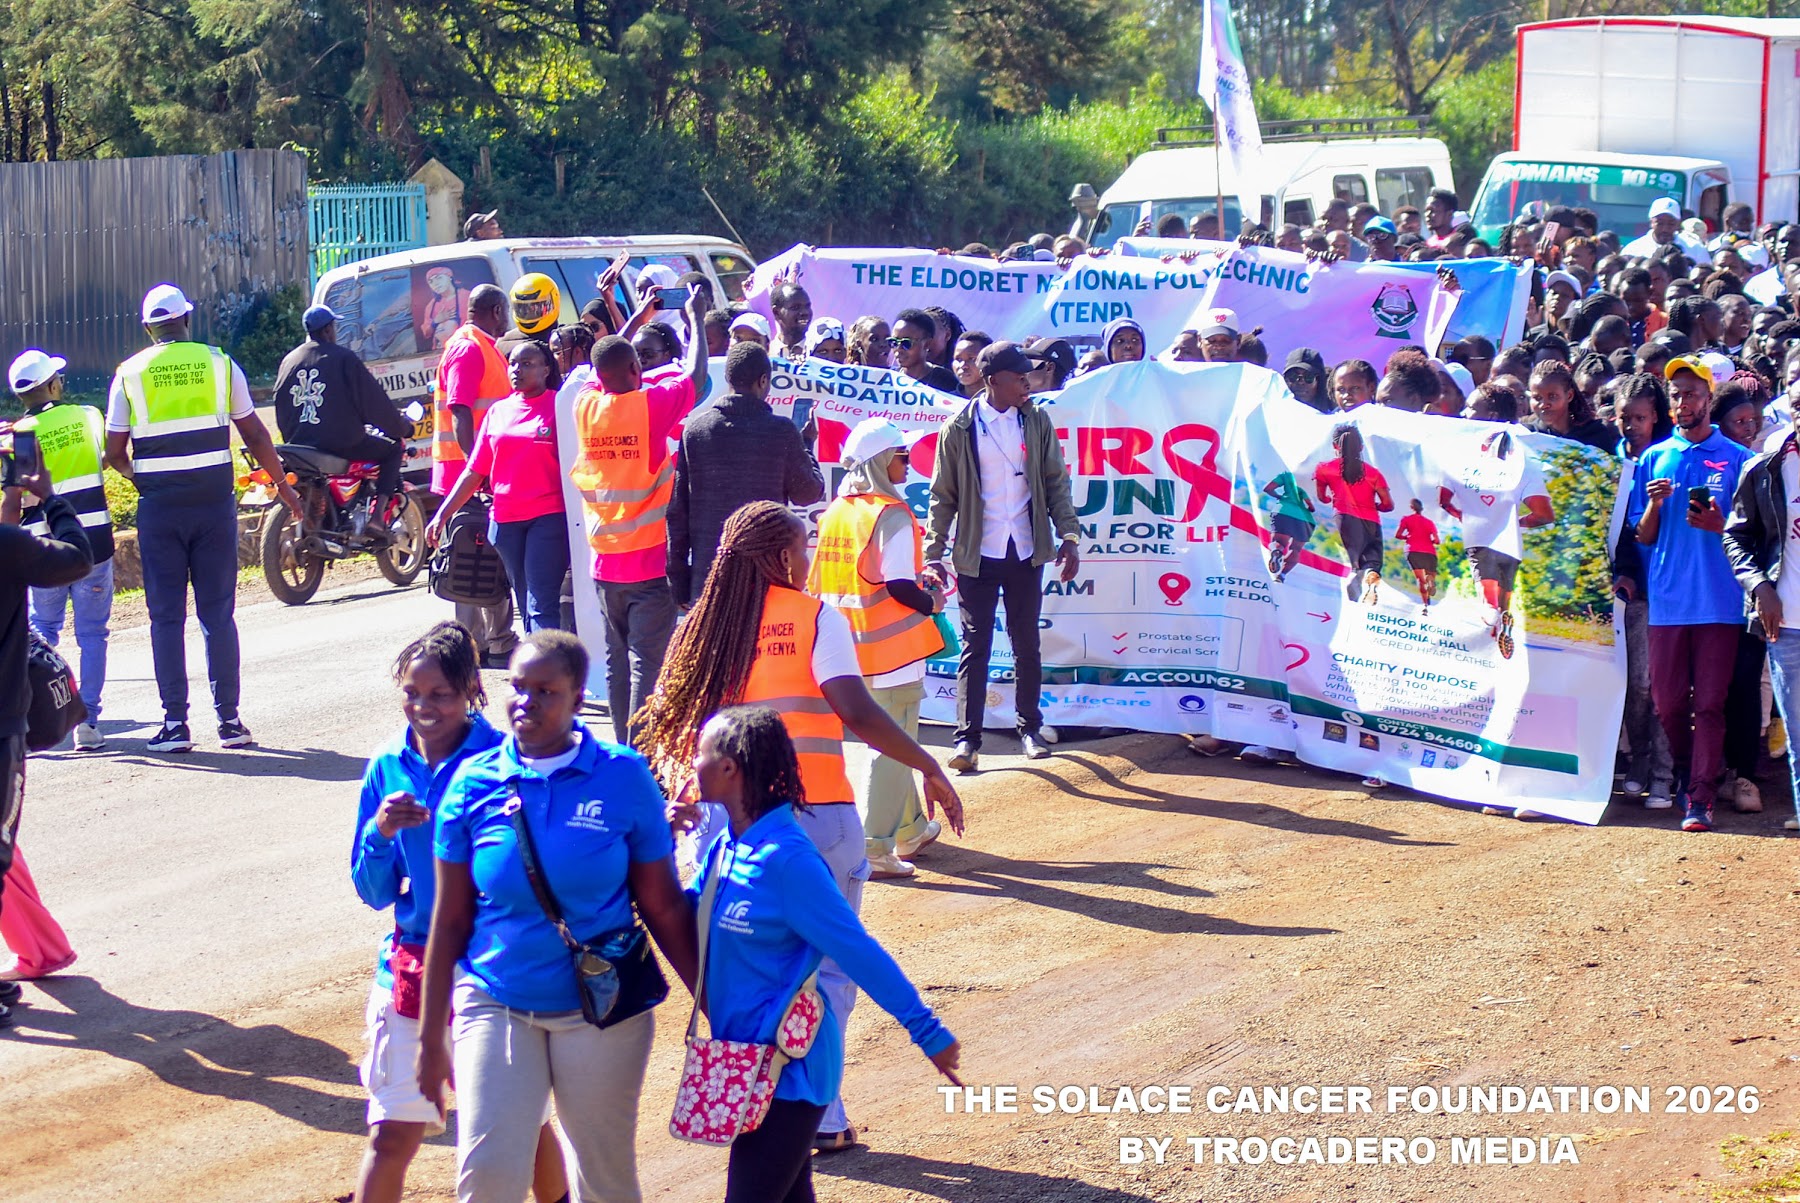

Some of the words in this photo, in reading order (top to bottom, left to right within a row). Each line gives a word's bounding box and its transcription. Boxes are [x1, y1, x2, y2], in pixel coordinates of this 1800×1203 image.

[1492, 162, 1601, 184] ROMANS
[1621, 169, 1678, 190] 10:9
[851, 262, 903, 286] THE
[911, 266, 1029, 293] ELDORET
[1051, 301, 1133, 328] (TENP)
[148, 363, 191, 375] CONTACT
[193, 362, 207, 370] US
[153, 373, 172, 382] 0706
[174, 372, 188, 380] 900
[190, 370, 204, 379] 707
[154, 380, 172, 388] 0711
[174, 378, 188, 387] 900
[190, 377, 205, 386] 706
[770, 374, 936, 407] OUNDATION
[823, 400, 864, 417] Cure
[867, 408, 912, 422] when
[914, 410, 948, 423] there
[36, 426, 70, 441] ONTACT
[72, 422, 84, 430] US
[614, 435, 638, 446] CANCER
[1109, 522, 1175, 540] FOR
[1087, 543, 1176, 556] ALONE.
[1366, 612, 1417, 630] BISHOP
[763, 622, 795, 640] CANCER
[1138, 632, 1193, 642] Prostate
[1366, 624, 1436, 646] MEMORIAL
[1439, 639, 1470, 652] HALL
[767, 642, 797, 656] KENYA
[1138, 646, 1192, 655] Cervical
[1332, 652, 1398, 674] CHARITY
[1402, 667, 1479, 691] PURPOSE
[1405, 680, 1428, 691] 100
[1064, 694, 1152, 707] LifeCare
[1377, 717, 1430, 732] CONTACT:
[1378, 724, 1421, 738] 0724
[1424, 731, 1483, 754] 944609
